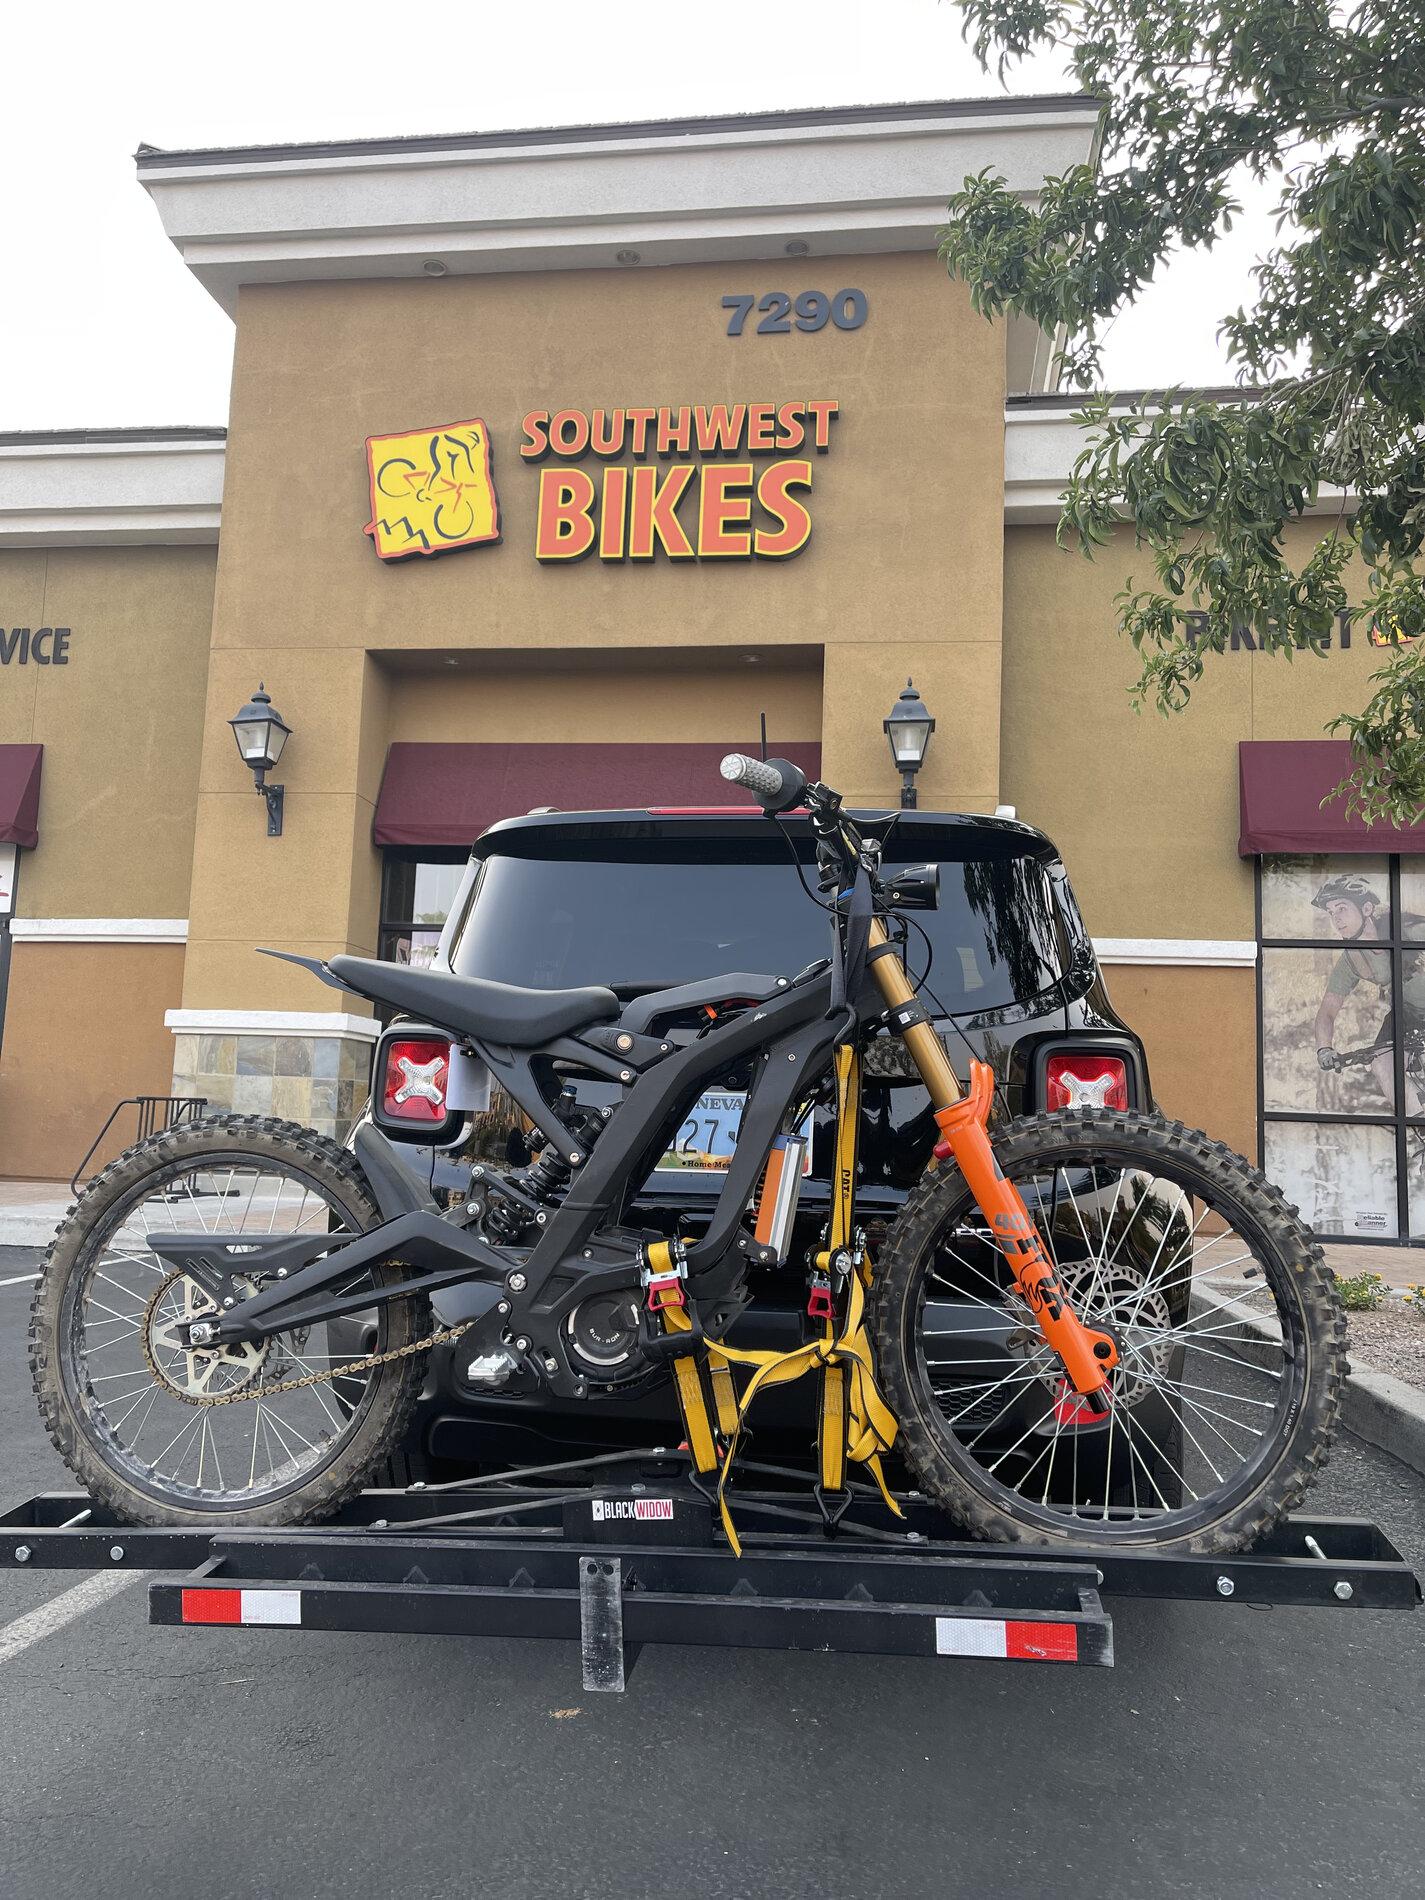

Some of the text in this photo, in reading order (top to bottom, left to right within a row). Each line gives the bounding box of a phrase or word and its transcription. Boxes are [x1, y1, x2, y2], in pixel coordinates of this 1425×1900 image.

[722, 288, 868, 336] 7290
[520, 401, 838, 460] SOUTHWEST
[535, 460, 812, 562] BIKES
[0, 628, 71, 664] VICE
[696, 1097, 744, 1111] NEVA
[667, 1119, 719, 1153] 27
[688, 1160, 730, 1169] Home Mea
[604, 1501, 672, 1519] BLACK WIDOW
